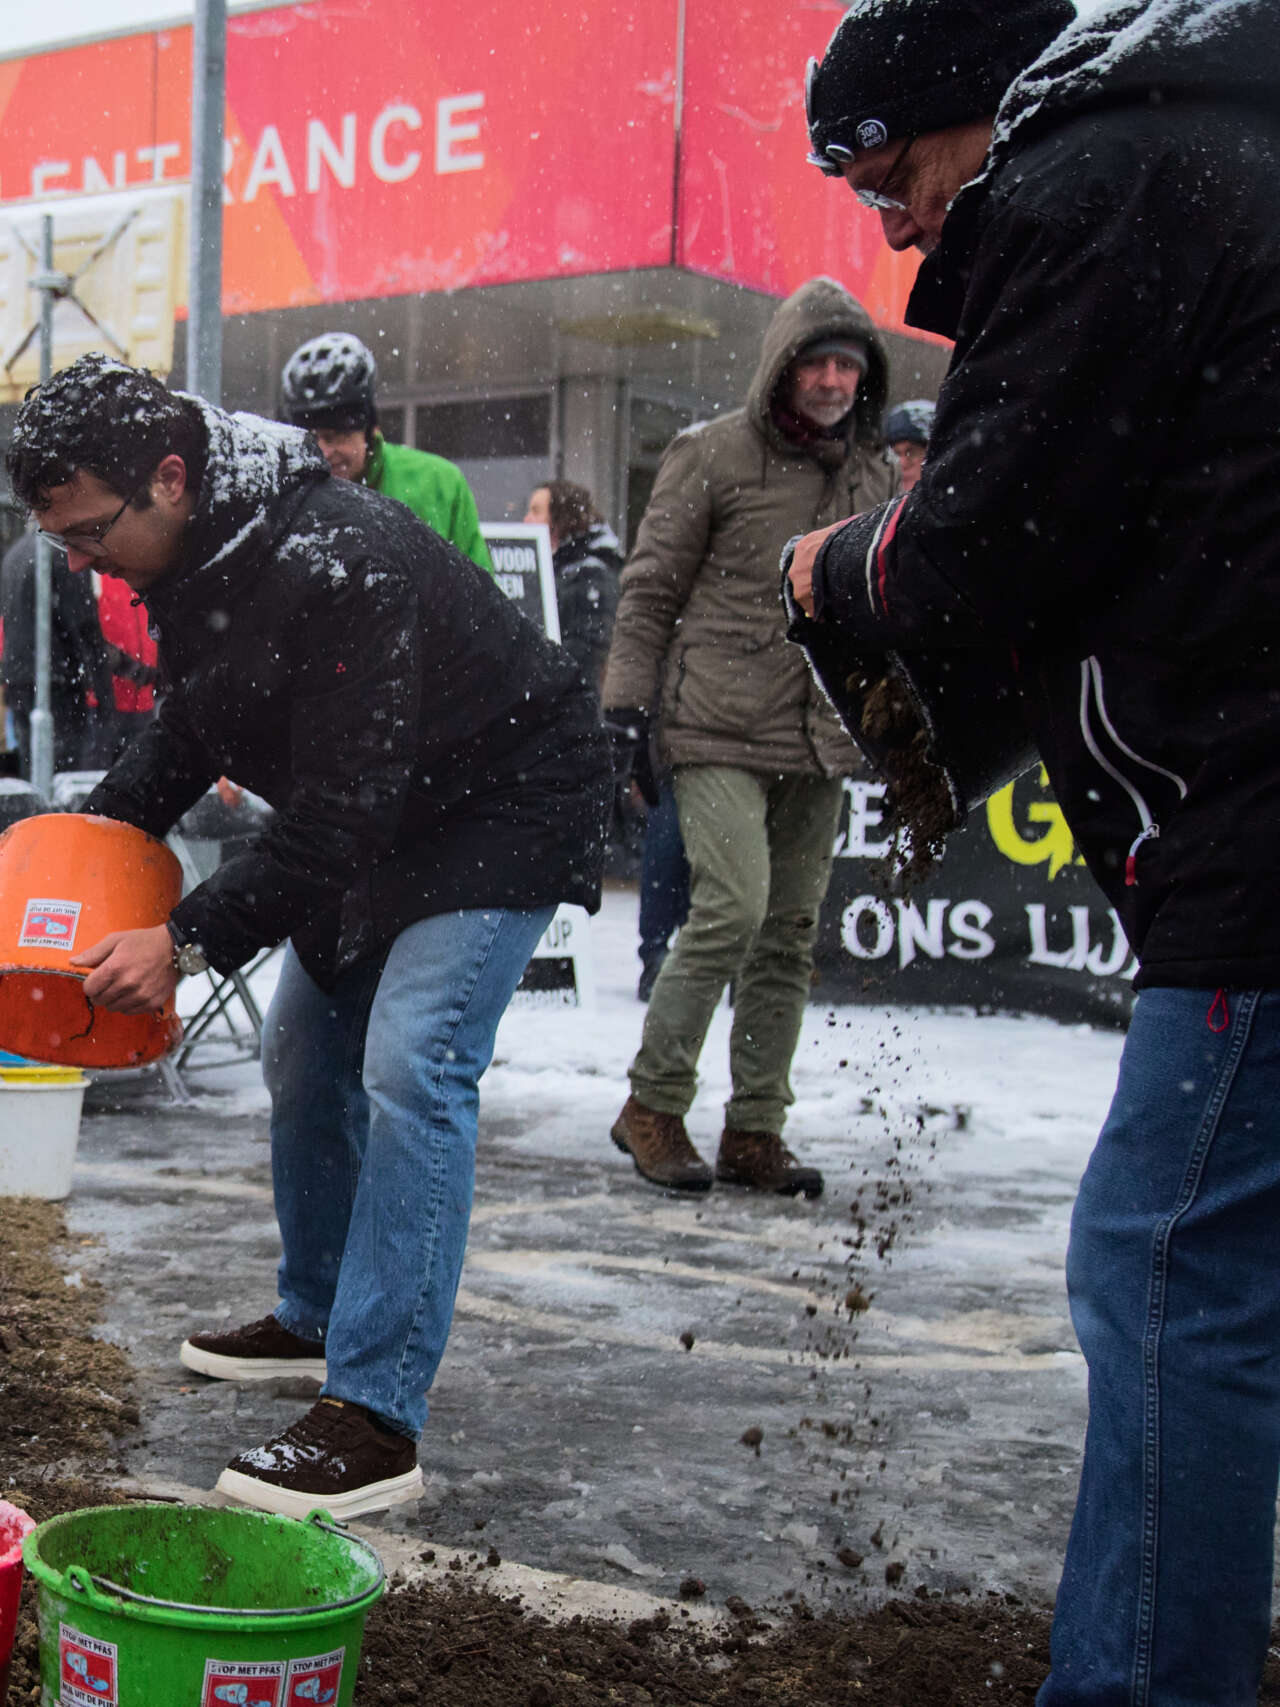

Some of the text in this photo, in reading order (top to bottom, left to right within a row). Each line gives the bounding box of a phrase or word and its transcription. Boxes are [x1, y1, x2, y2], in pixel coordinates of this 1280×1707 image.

[859, 124, 877, 139] 300
[841, 895, 995, 970] ONS
[1024, 903, 1142, 981] LIJ
[93, 1643, 112, 1655] PFAS
[238, 1666, 258, 1675] MET
[259, 1666, 281, 1675] PFAS
[293, 1662, 312, 1672] STOP
[313, 1657, 328, 1669] MET
[74, 1689, 85, 1700] UIT
[87, 1694, 97, 1704] DE
